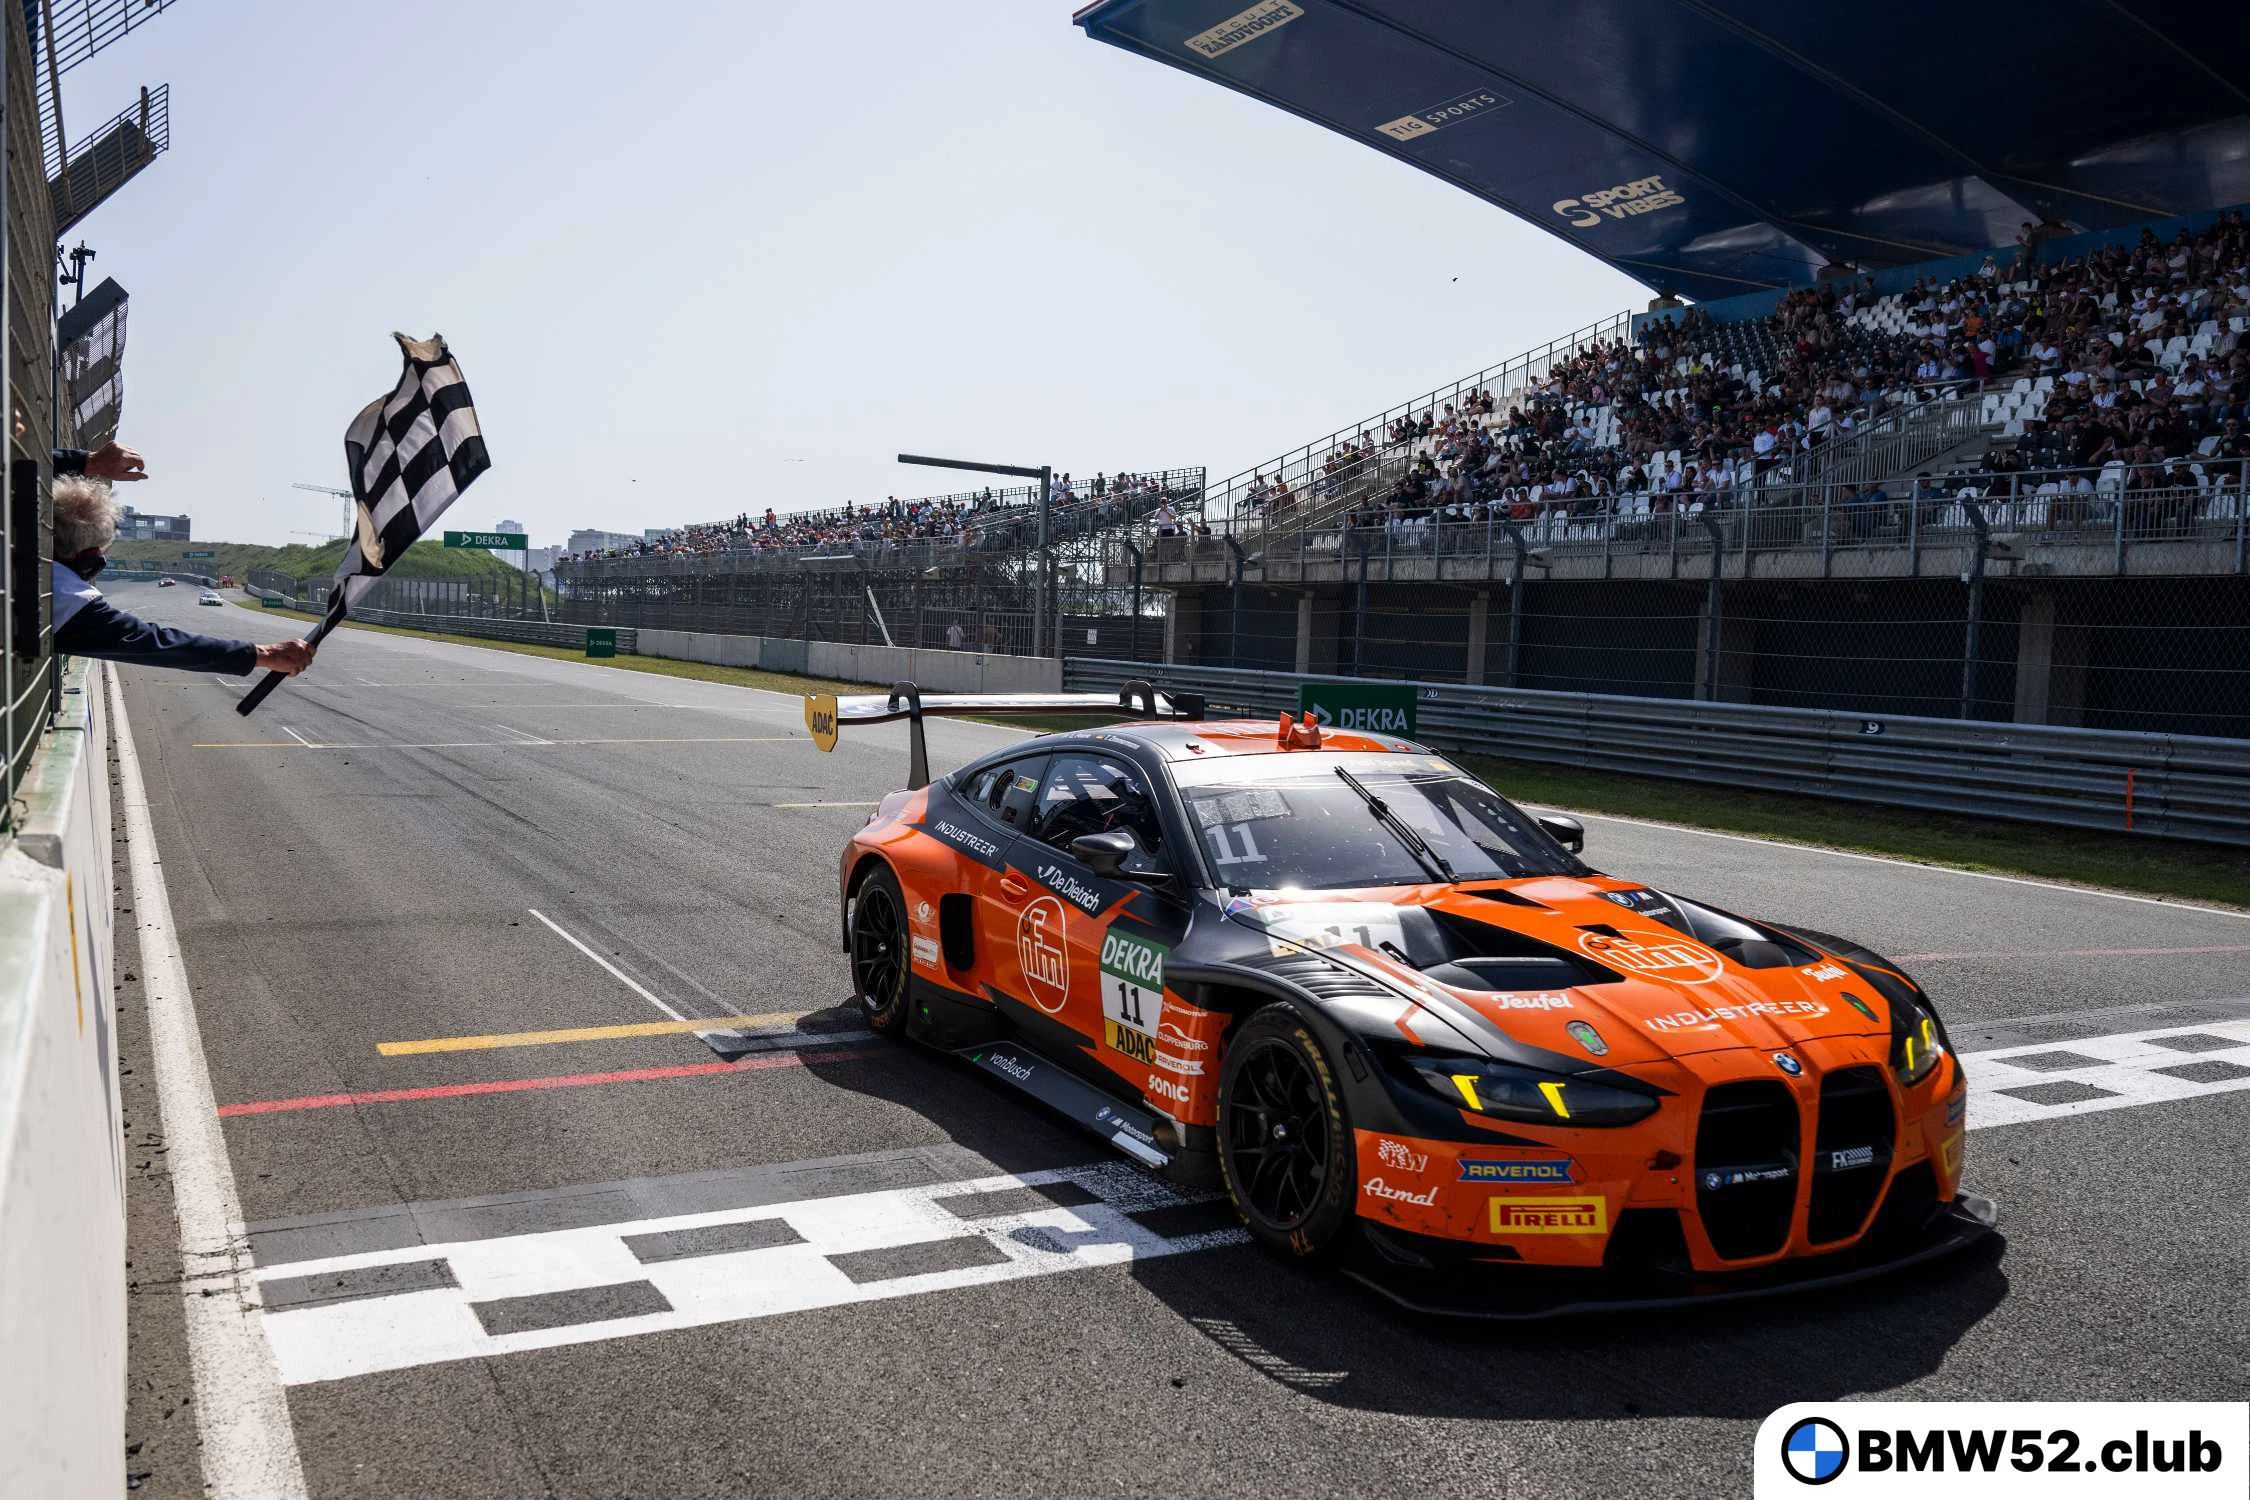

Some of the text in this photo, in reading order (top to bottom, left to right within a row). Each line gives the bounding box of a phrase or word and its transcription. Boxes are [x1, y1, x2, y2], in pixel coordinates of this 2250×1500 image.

[1192, 0, 1281, 47] CIRCUIT
[1200, 5, 1294, 53] ZANDVOORT
[1389, 94, 1496, 135] TIG SPORTS
[1581, 174, 1665, 208] SPORT
[1601, 190, 1686, 219] VIBES
[475, 535, 509, 546] DEKRA
[812, 711, 834, 737] ADAC
[1340, 708, 1408, 731] DEKRA
[934, 820, 999, 857] INDUSTREER
[1206, 822, 1269, 865] 11
[1049, 869, 1101, 912] De Dietrich
[1101, 934, 1163, 986] DEKRA
[1118, 982, 1145, 1027] 11
[1490, 993, 1575, 1011] Teufel
[1645, 1001, 1818, 1030] INDUSTREER
[1115, 1025, 1155, 1064] ADAC
[990, 1053, 1035, 1081] vonBusch
[1468, 1165, 1563, 1177] RAVENOL
[1500, 1204, 1596, 1226] PIRELLI
